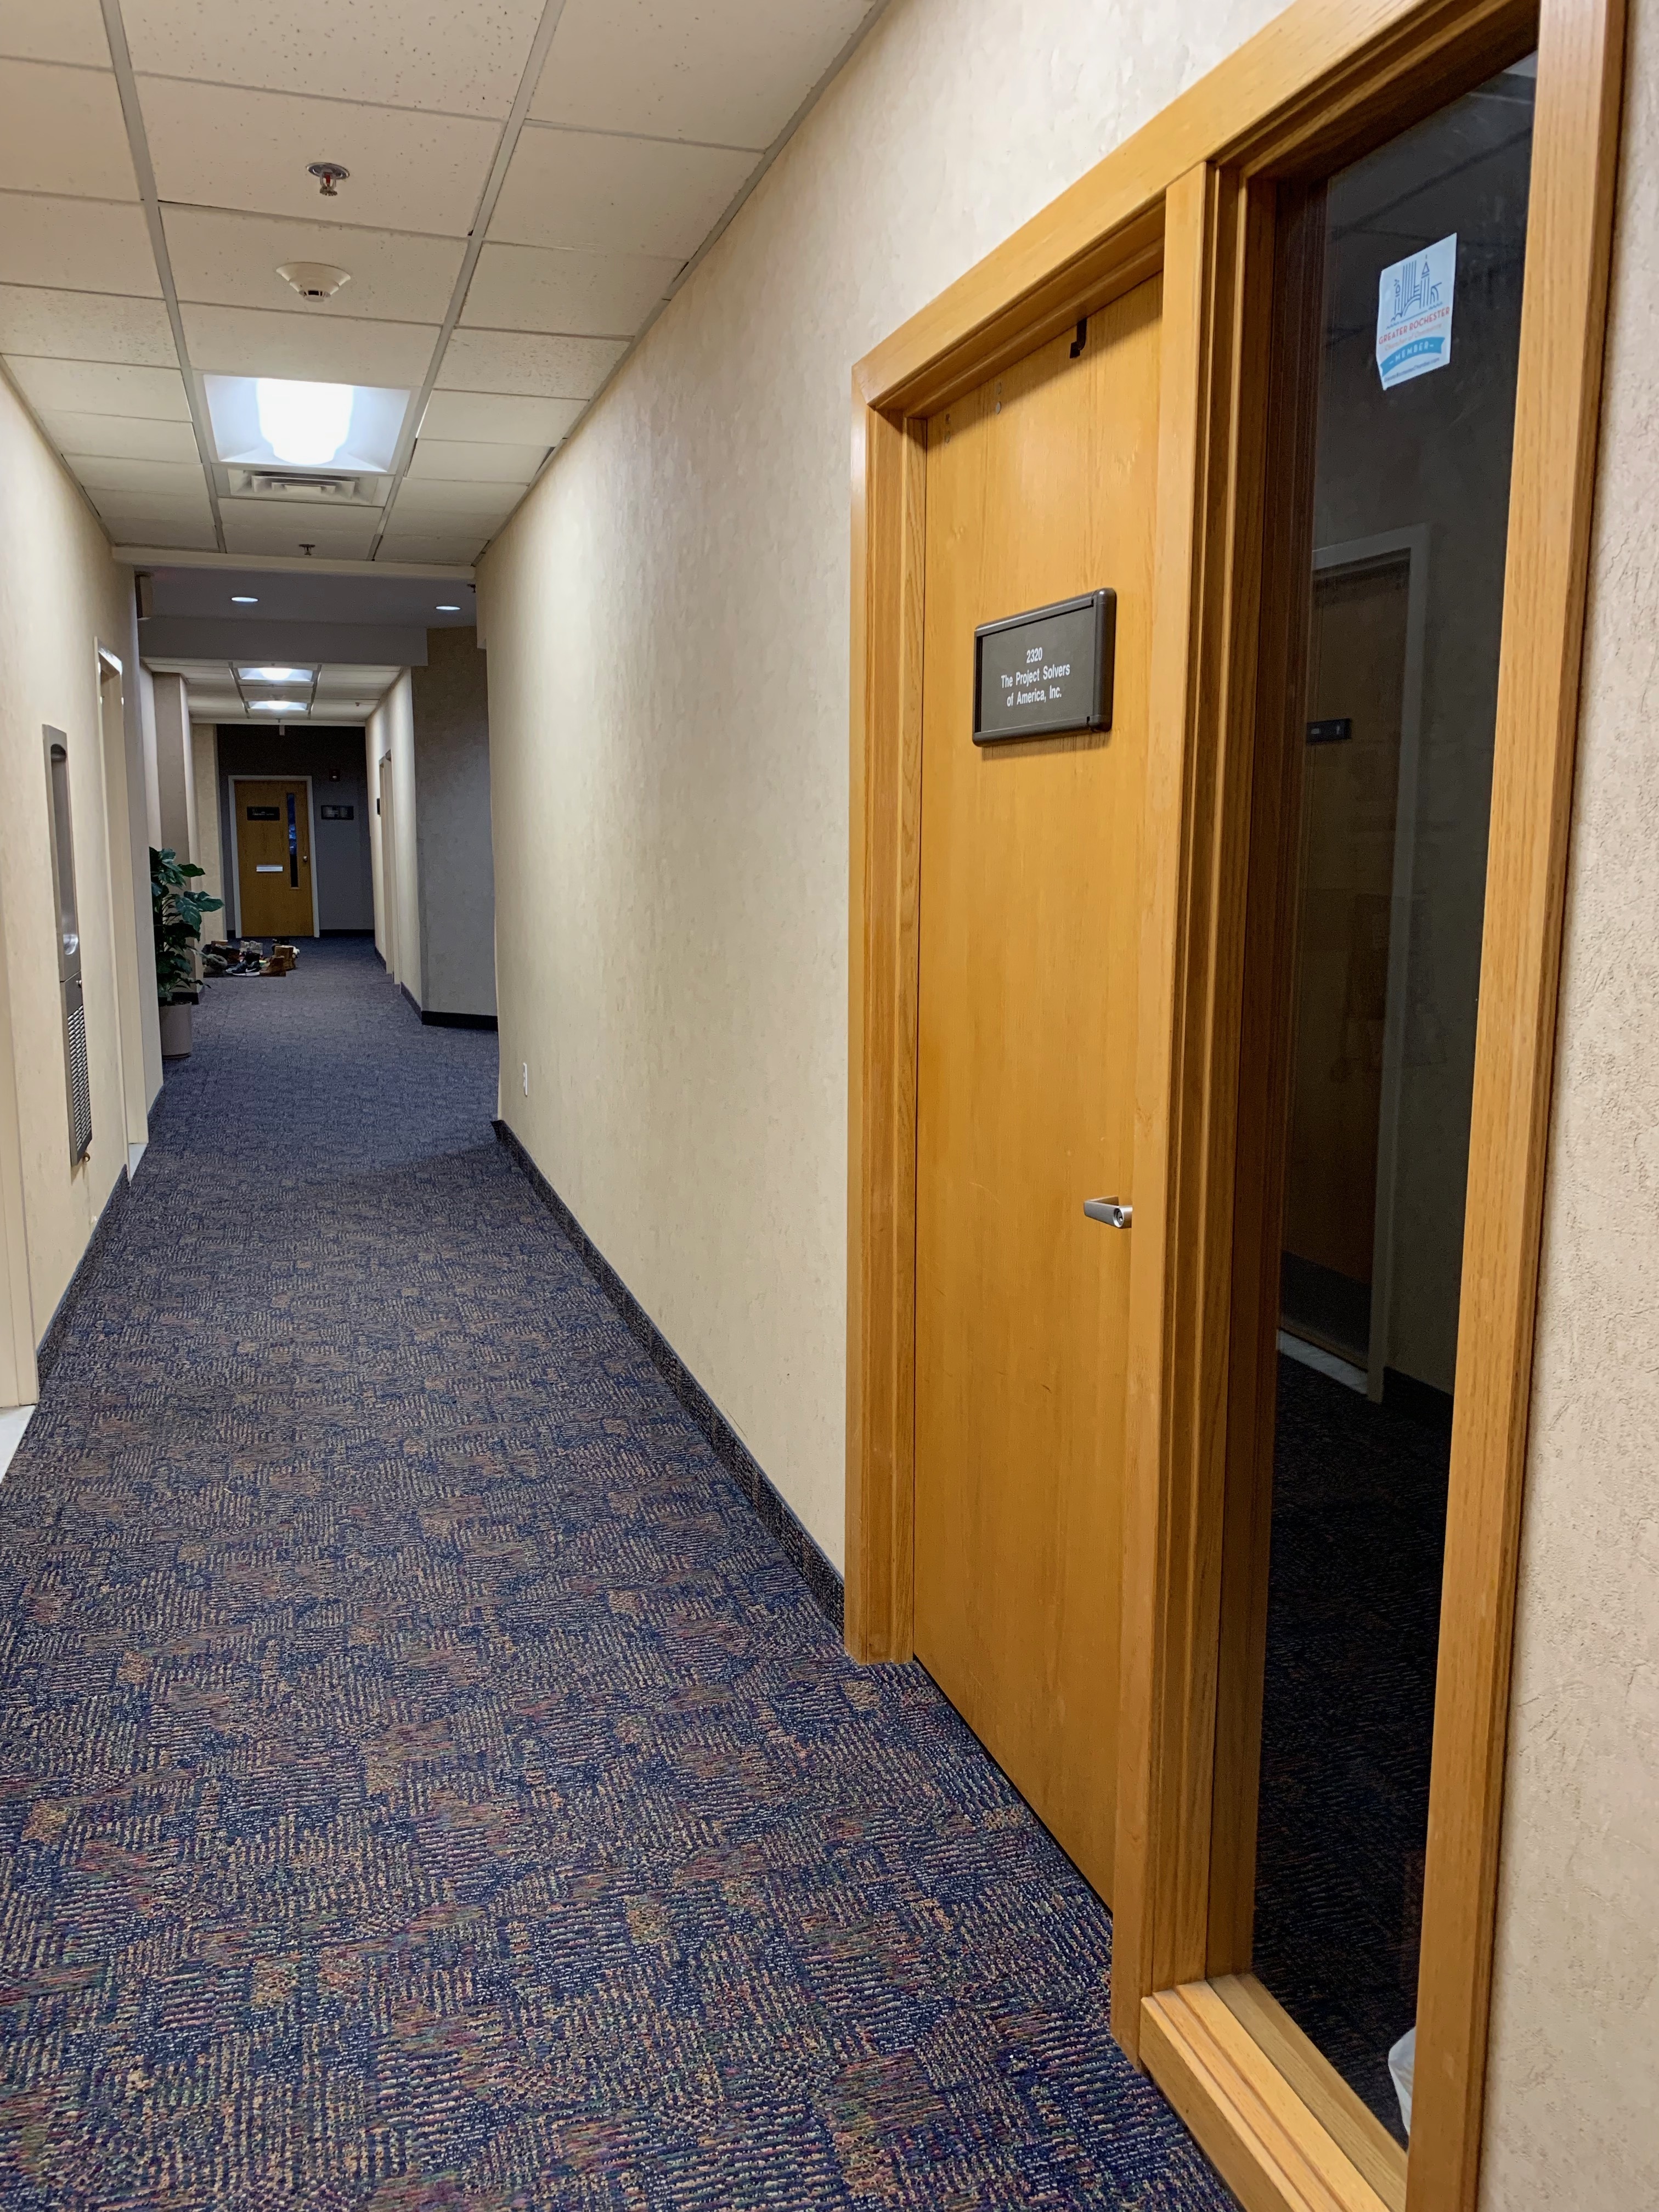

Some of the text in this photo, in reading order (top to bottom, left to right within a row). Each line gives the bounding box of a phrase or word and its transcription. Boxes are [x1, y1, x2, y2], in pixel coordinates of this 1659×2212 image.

[1409, 307, 1450, 331] ROCHESTER
[1026, 647, 1043, 663] 2320
[1001, 664, 1070, 689] The Project Solvers
[1007, 685, 1062, 707] of America, Inc.
